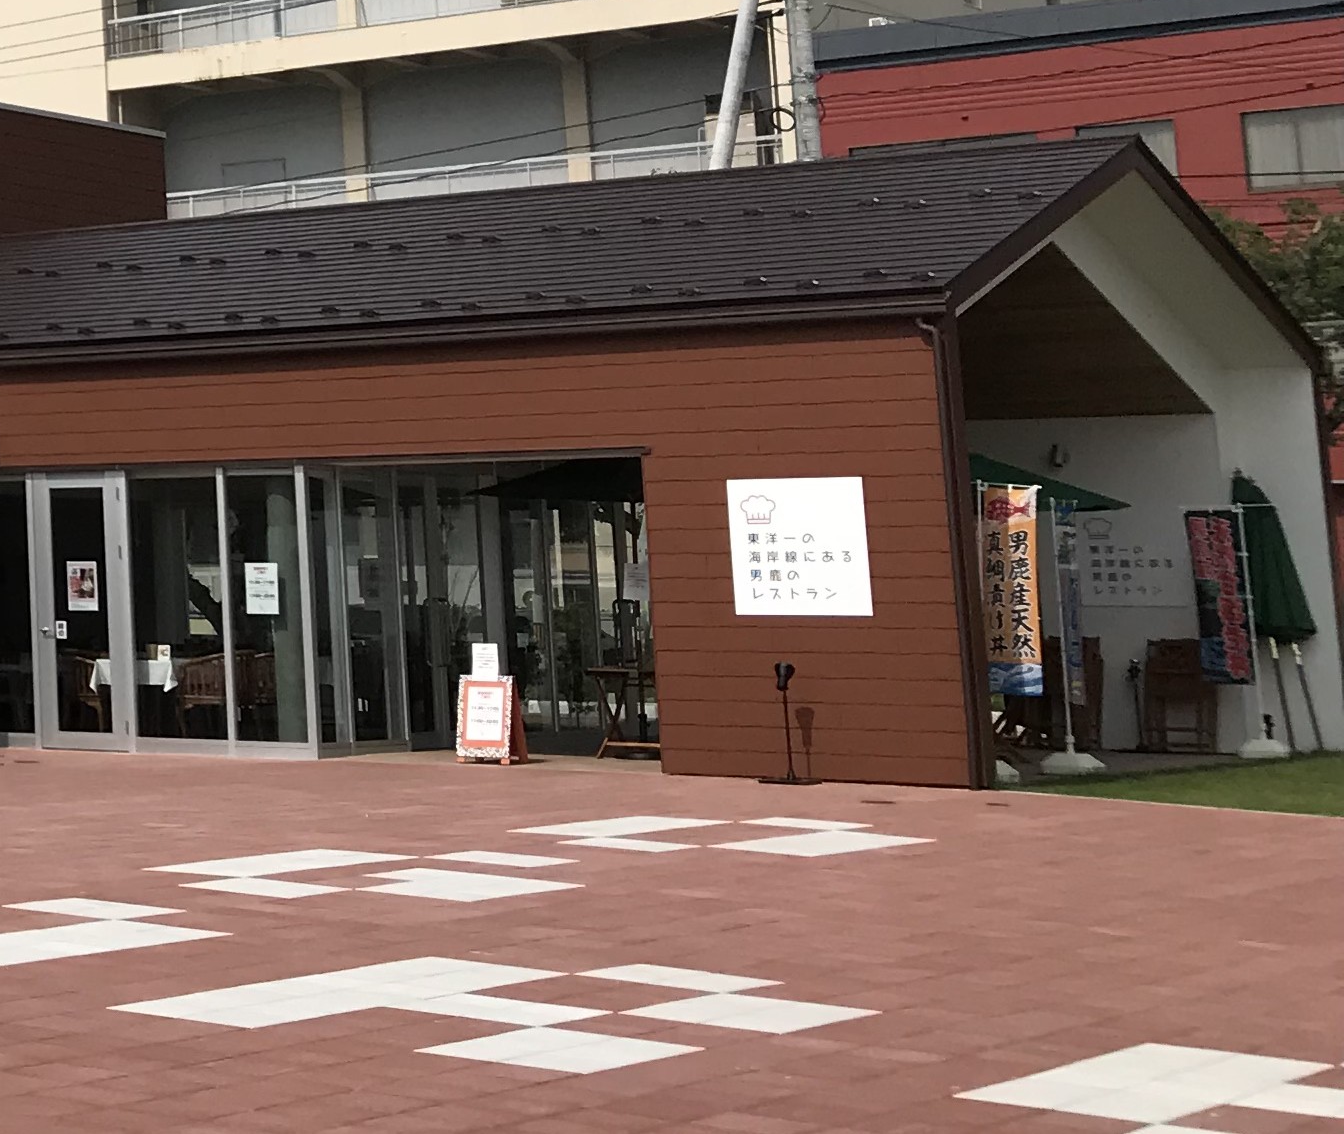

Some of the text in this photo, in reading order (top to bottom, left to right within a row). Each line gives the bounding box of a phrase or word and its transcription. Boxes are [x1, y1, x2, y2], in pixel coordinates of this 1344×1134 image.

[748, 532, 815, 546] 東洋一の
[748, 550, 853, 564] 海岸線にある
[750, 568, 800, 582] 男鹿の
[752, 587, 838, 601] レストラン
[1008, 530, 1037, 659] 男鹿産天然
